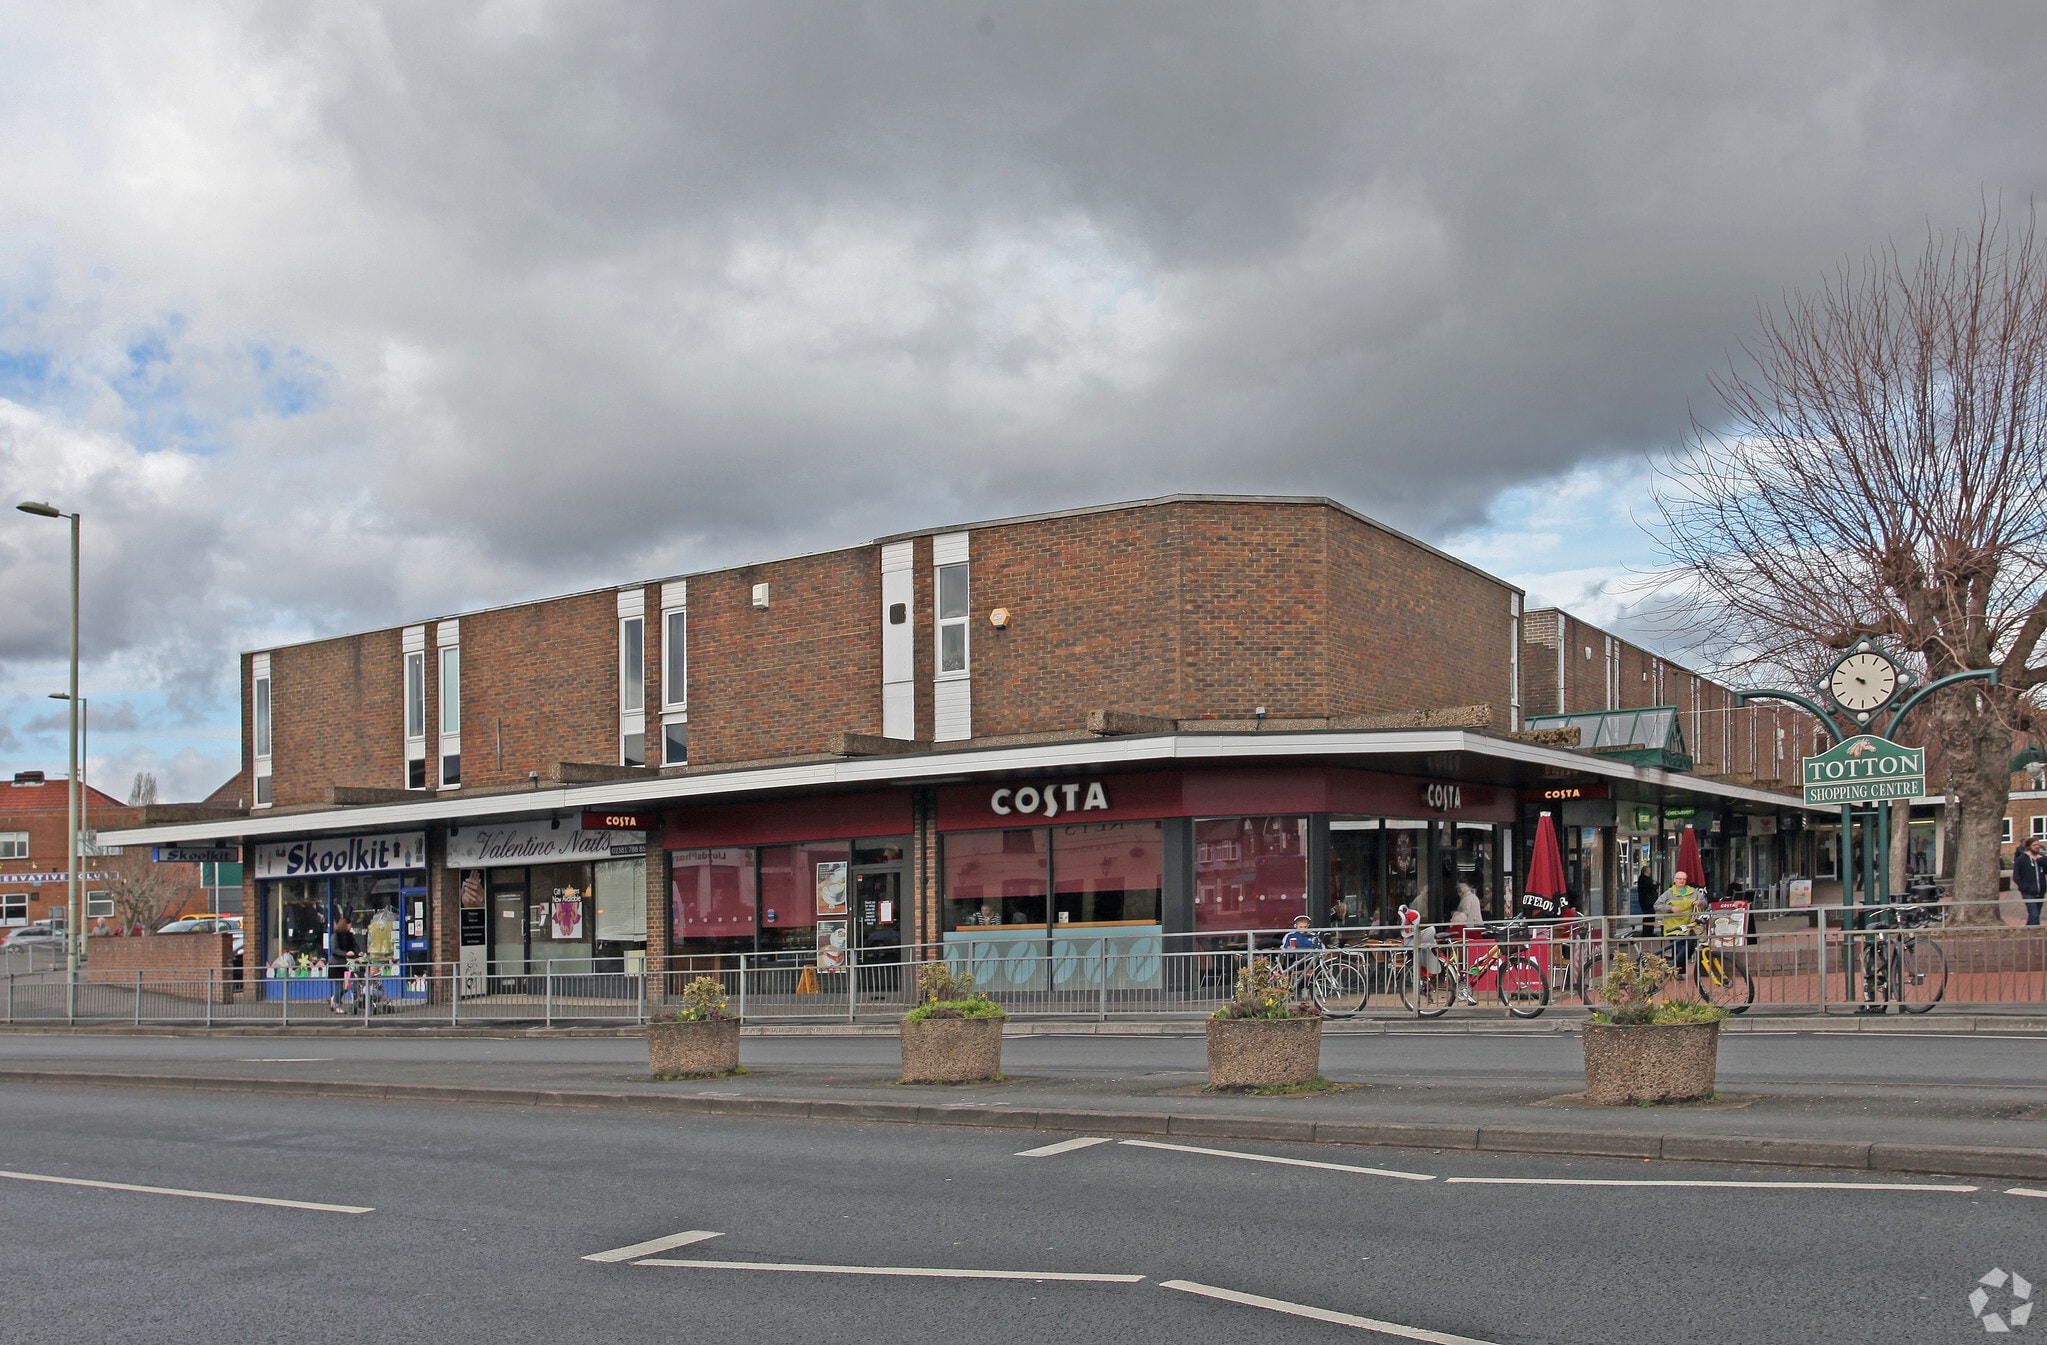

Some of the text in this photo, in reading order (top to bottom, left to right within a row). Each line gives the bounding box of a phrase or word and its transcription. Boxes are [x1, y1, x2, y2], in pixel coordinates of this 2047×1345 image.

[1809, 754, 1920, 780] TOTTON
[991, 782, 1108, 817] COSTA
[1428, 784, 1461, 811] COSTA
[1545, 789, 1580, 799] COSTA
[1811, 782, 1918, 801] SHOPPING CENTRE
[606, 816, 637, 827] COSTA
[167, 850, 231, 860] Skoolkit
[287, 839, 389, 874] Skoolkit
[477, 830, 611, 859] Valentino Nails
